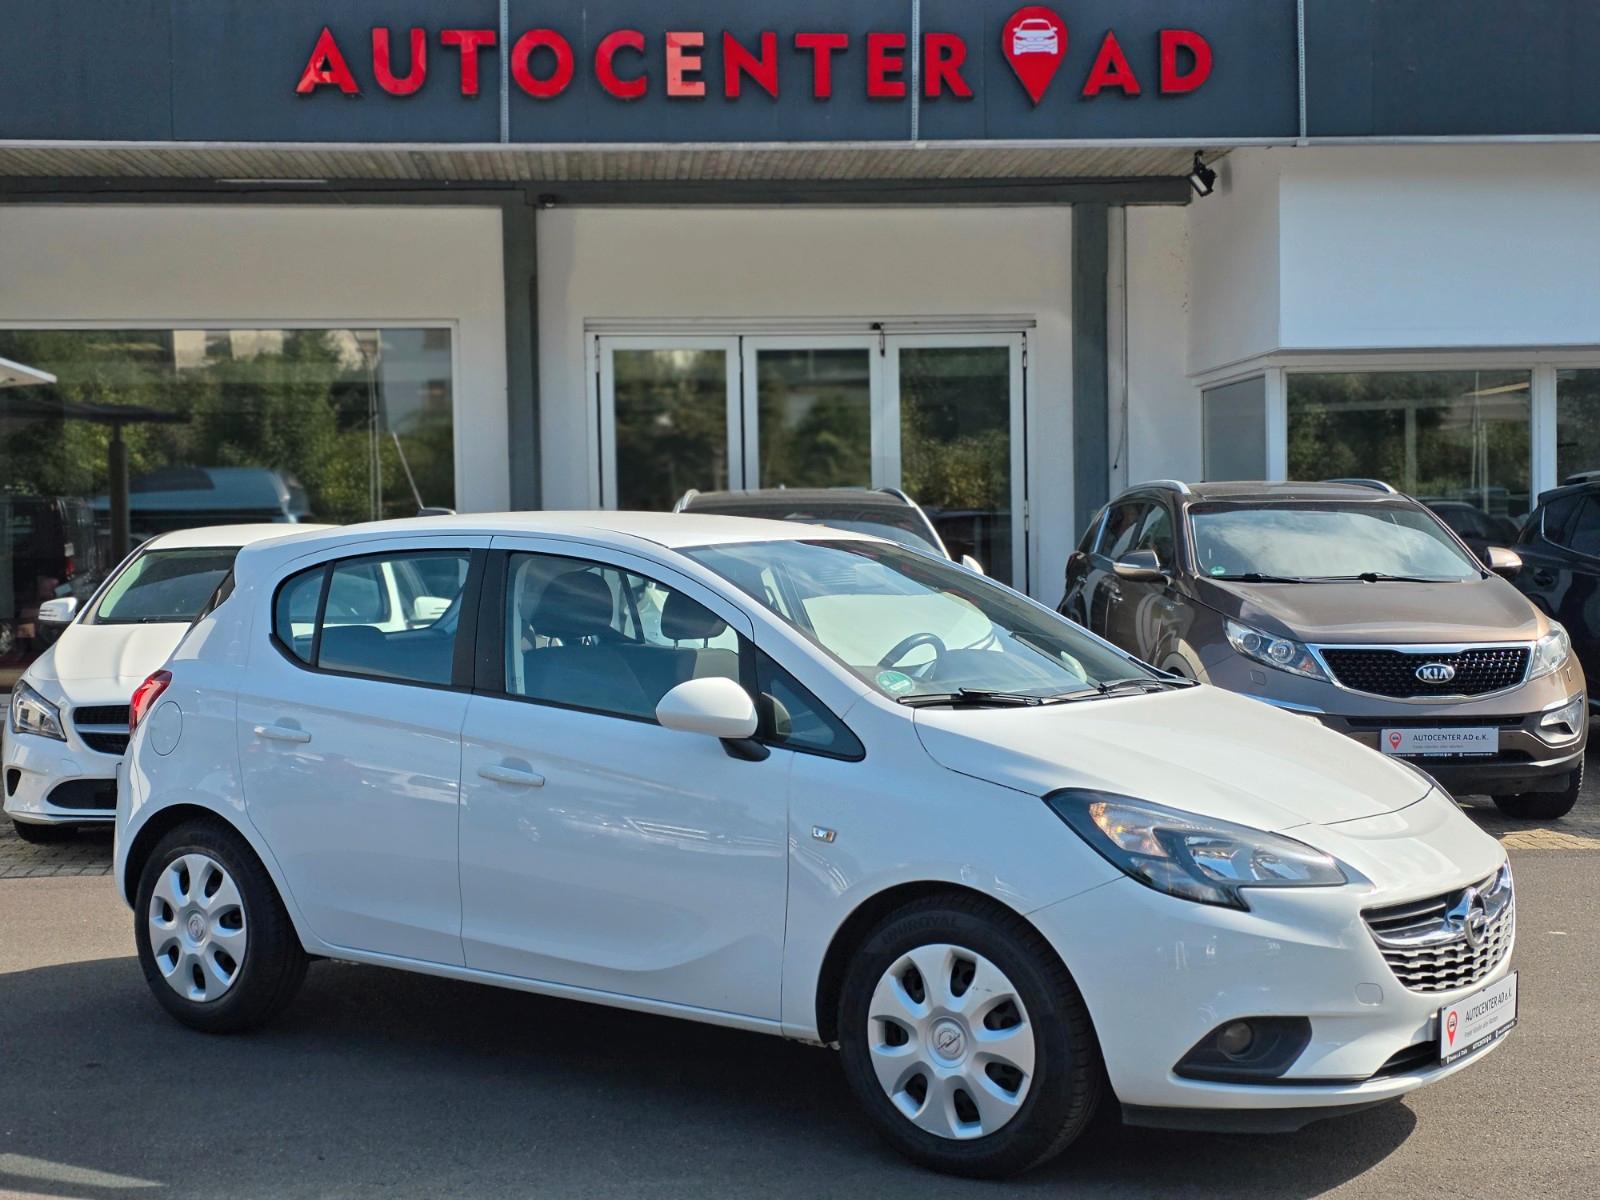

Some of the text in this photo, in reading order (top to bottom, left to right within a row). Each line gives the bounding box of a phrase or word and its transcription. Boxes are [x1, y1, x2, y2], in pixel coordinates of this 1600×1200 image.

[296, 27, 1213, 98] AUTOCENTER AD
[1422, 667, 1449, 680] KIA
[1413, 733, 1462, 742] AUTOCENTER
[1463, 733, 1474, 741] AD
[1465, 997, 1498, 1022] AUTOCENTER
[1498, 991, 1505, 1005] AD
